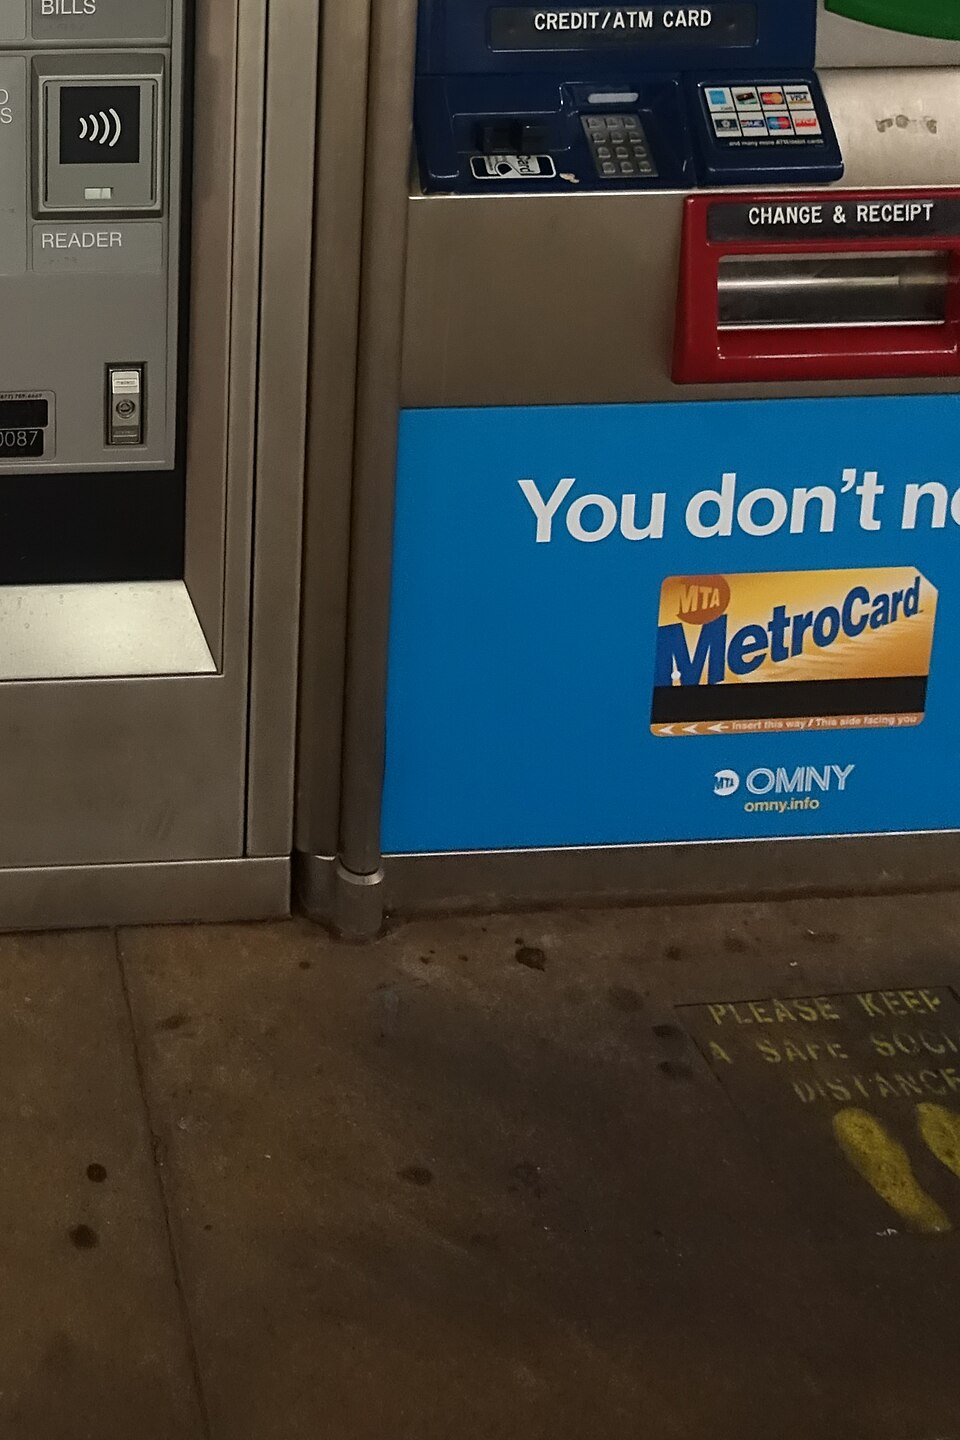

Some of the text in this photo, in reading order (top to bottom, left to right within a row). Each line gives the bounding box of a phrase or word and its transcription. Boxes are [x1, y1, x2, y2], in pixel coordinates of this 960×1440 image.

[534, 9, 712, 31] CREDIT/ATM CARD
[748, 203, 934, 226] CHANGE & RECEIPT
[41, 231, 122, 248] READER
[518, 478, 666, 543] You
[685, 468, 884, 538] don't
[676, 582, 720, 615] MTA
[654, 576, 921, 688] MetroCard
[732, 721, 762, 730] Insert
[764, 720, 784, 729] this
[786, 721, 806, 730] way
[815, 718, 838, 726] This
[840, 716, 862, 726] side
[864, 716, 896, 726] facing
[898, 716, 918, 724] you
[746, 764, 855, 795] OMNY
[744, 797, 820, 813] omny.info
[708, 990, 941, 1025] PLEASE KEEP
[756, 1039, 848, 1063] SAFE
